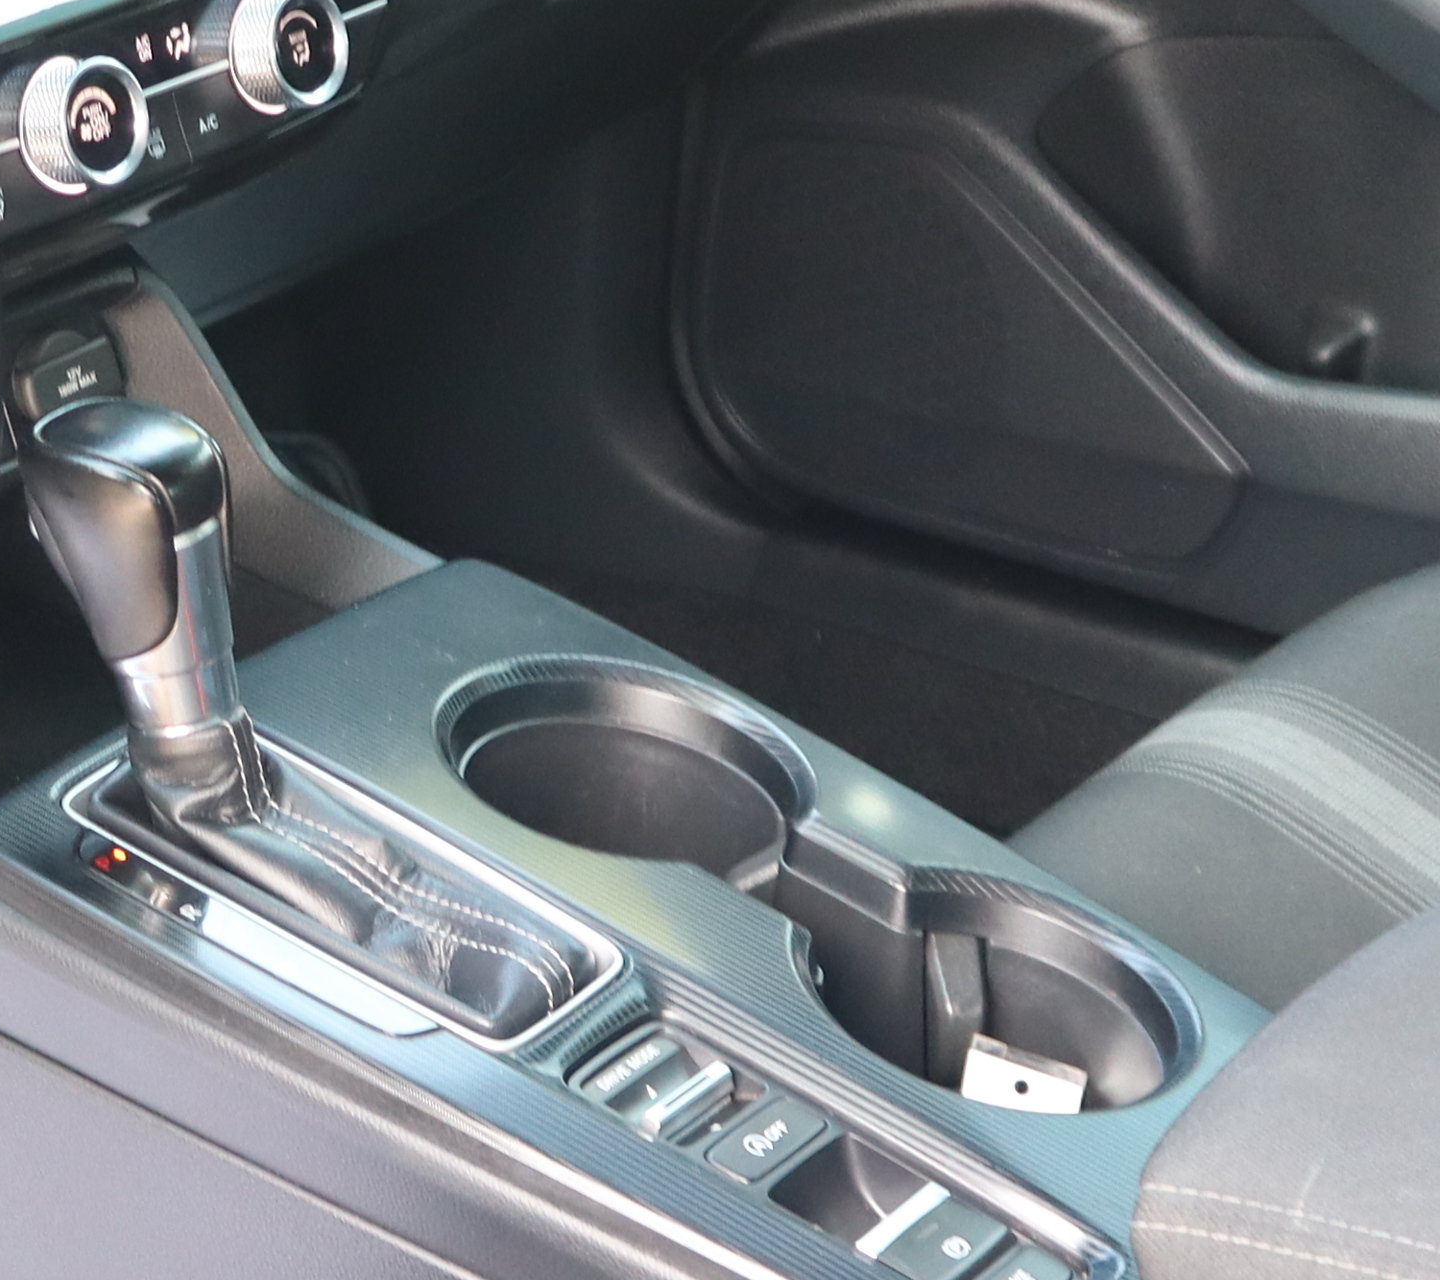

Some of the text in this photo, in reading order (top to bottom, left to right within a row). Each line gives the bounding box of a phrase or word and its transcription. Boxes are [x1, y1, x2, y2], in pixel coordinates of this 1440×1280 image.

[199, 113, 219, 134] A/C
[66, 364, 82, 382] 12V
[79, 369, 98, 389] MAX
